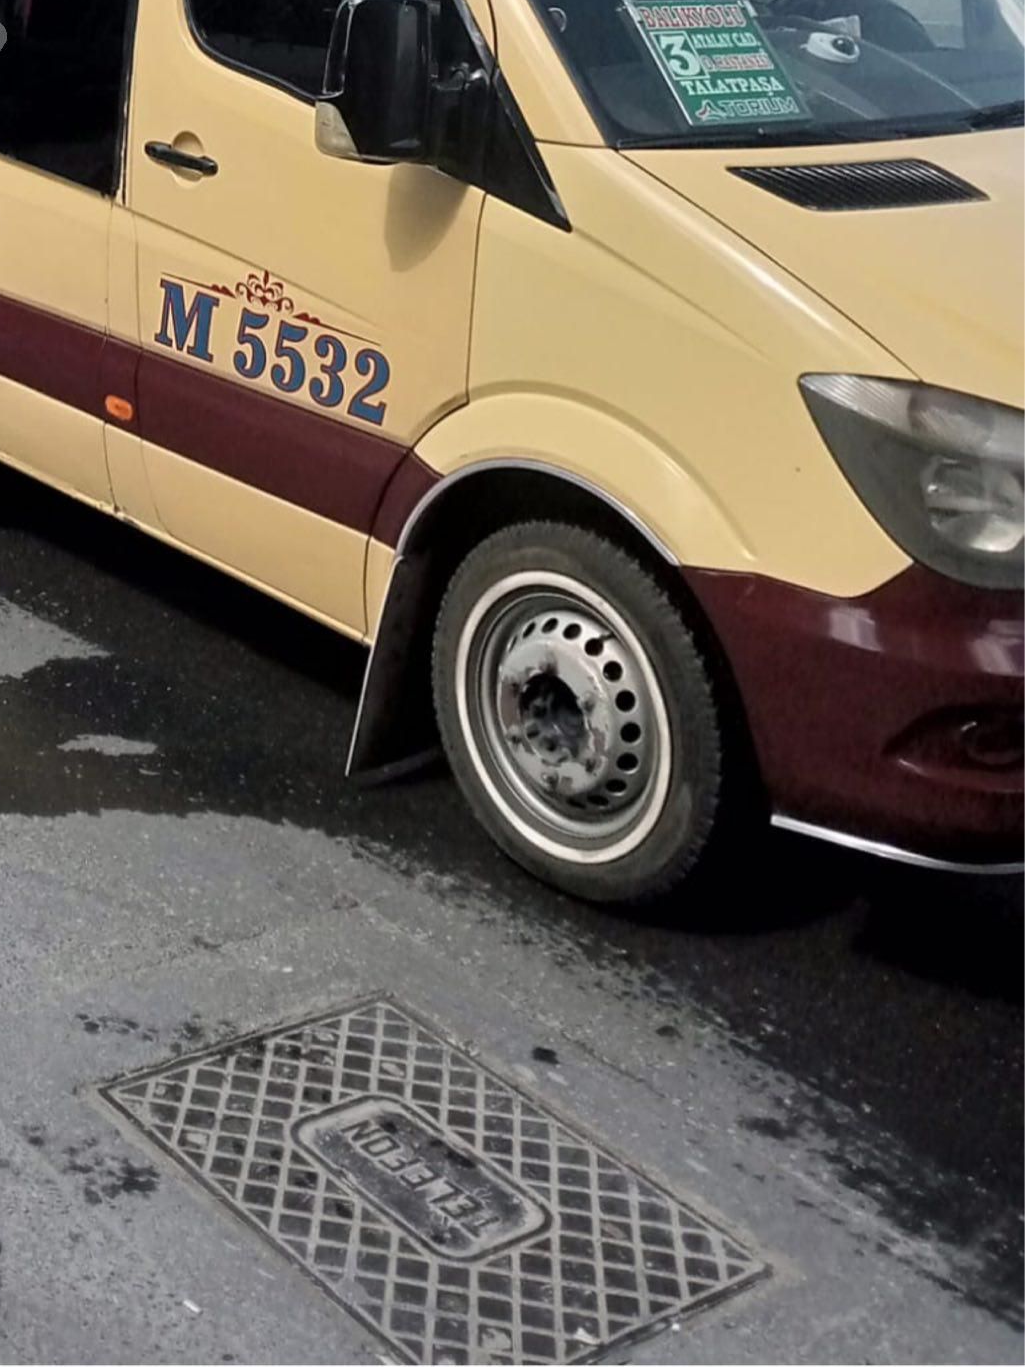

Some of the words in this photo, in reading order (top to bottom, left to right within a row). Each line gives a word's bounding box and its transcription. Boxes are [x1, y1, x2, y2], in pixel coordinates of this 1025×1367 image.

[640, 5, 747, 29] BALIKYOLU
[660, 35, 701, 76] 3
[680, 76, 785, 96] TALATPAŞA
[154, 278, 220, 363] M
[233, 307, 391, 426] 5532
[341, 1118, 501, 1239] TELEFON
